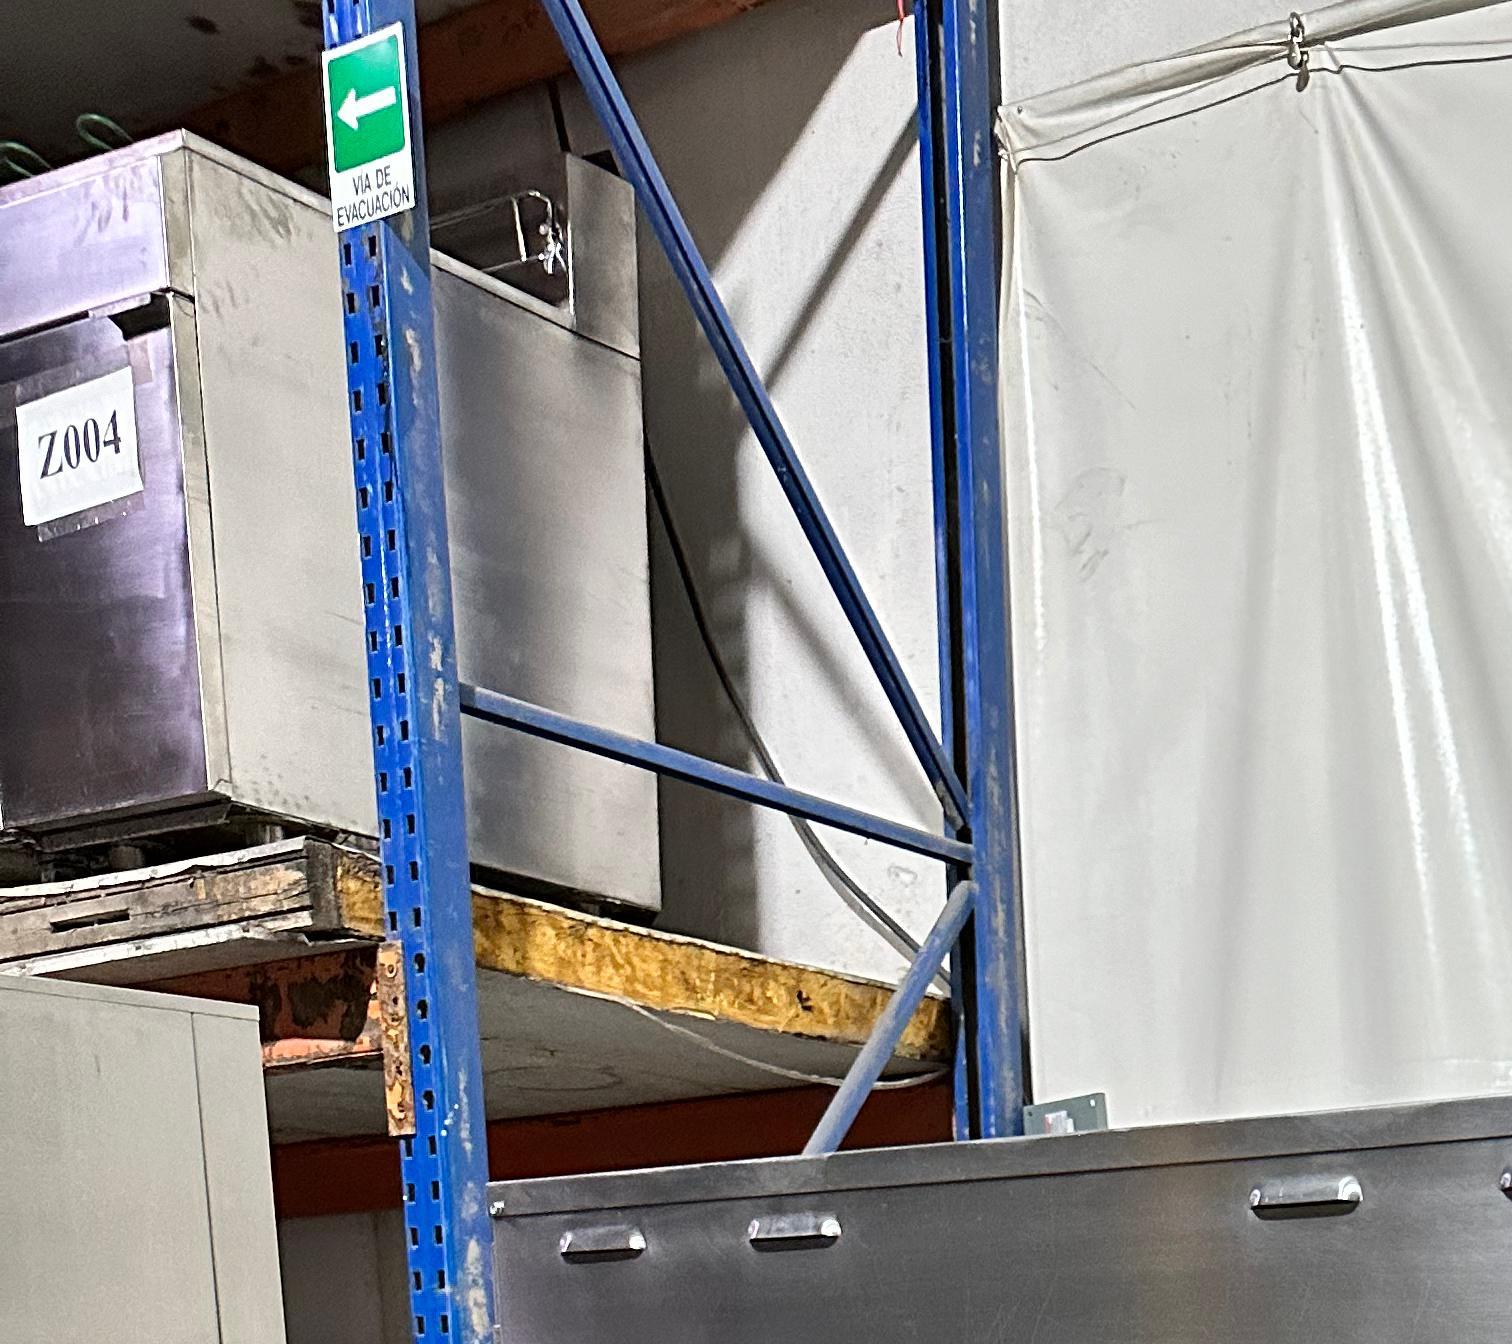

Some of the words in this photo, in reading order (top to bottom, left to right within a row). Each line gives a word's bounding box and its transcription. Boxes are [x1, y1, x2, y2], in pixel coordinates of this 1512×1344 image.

[375, 165, 391, 189] DE
[336, 181, 410, 226] EVACUACIÓN
[38, 409, 121, 479] Z004
